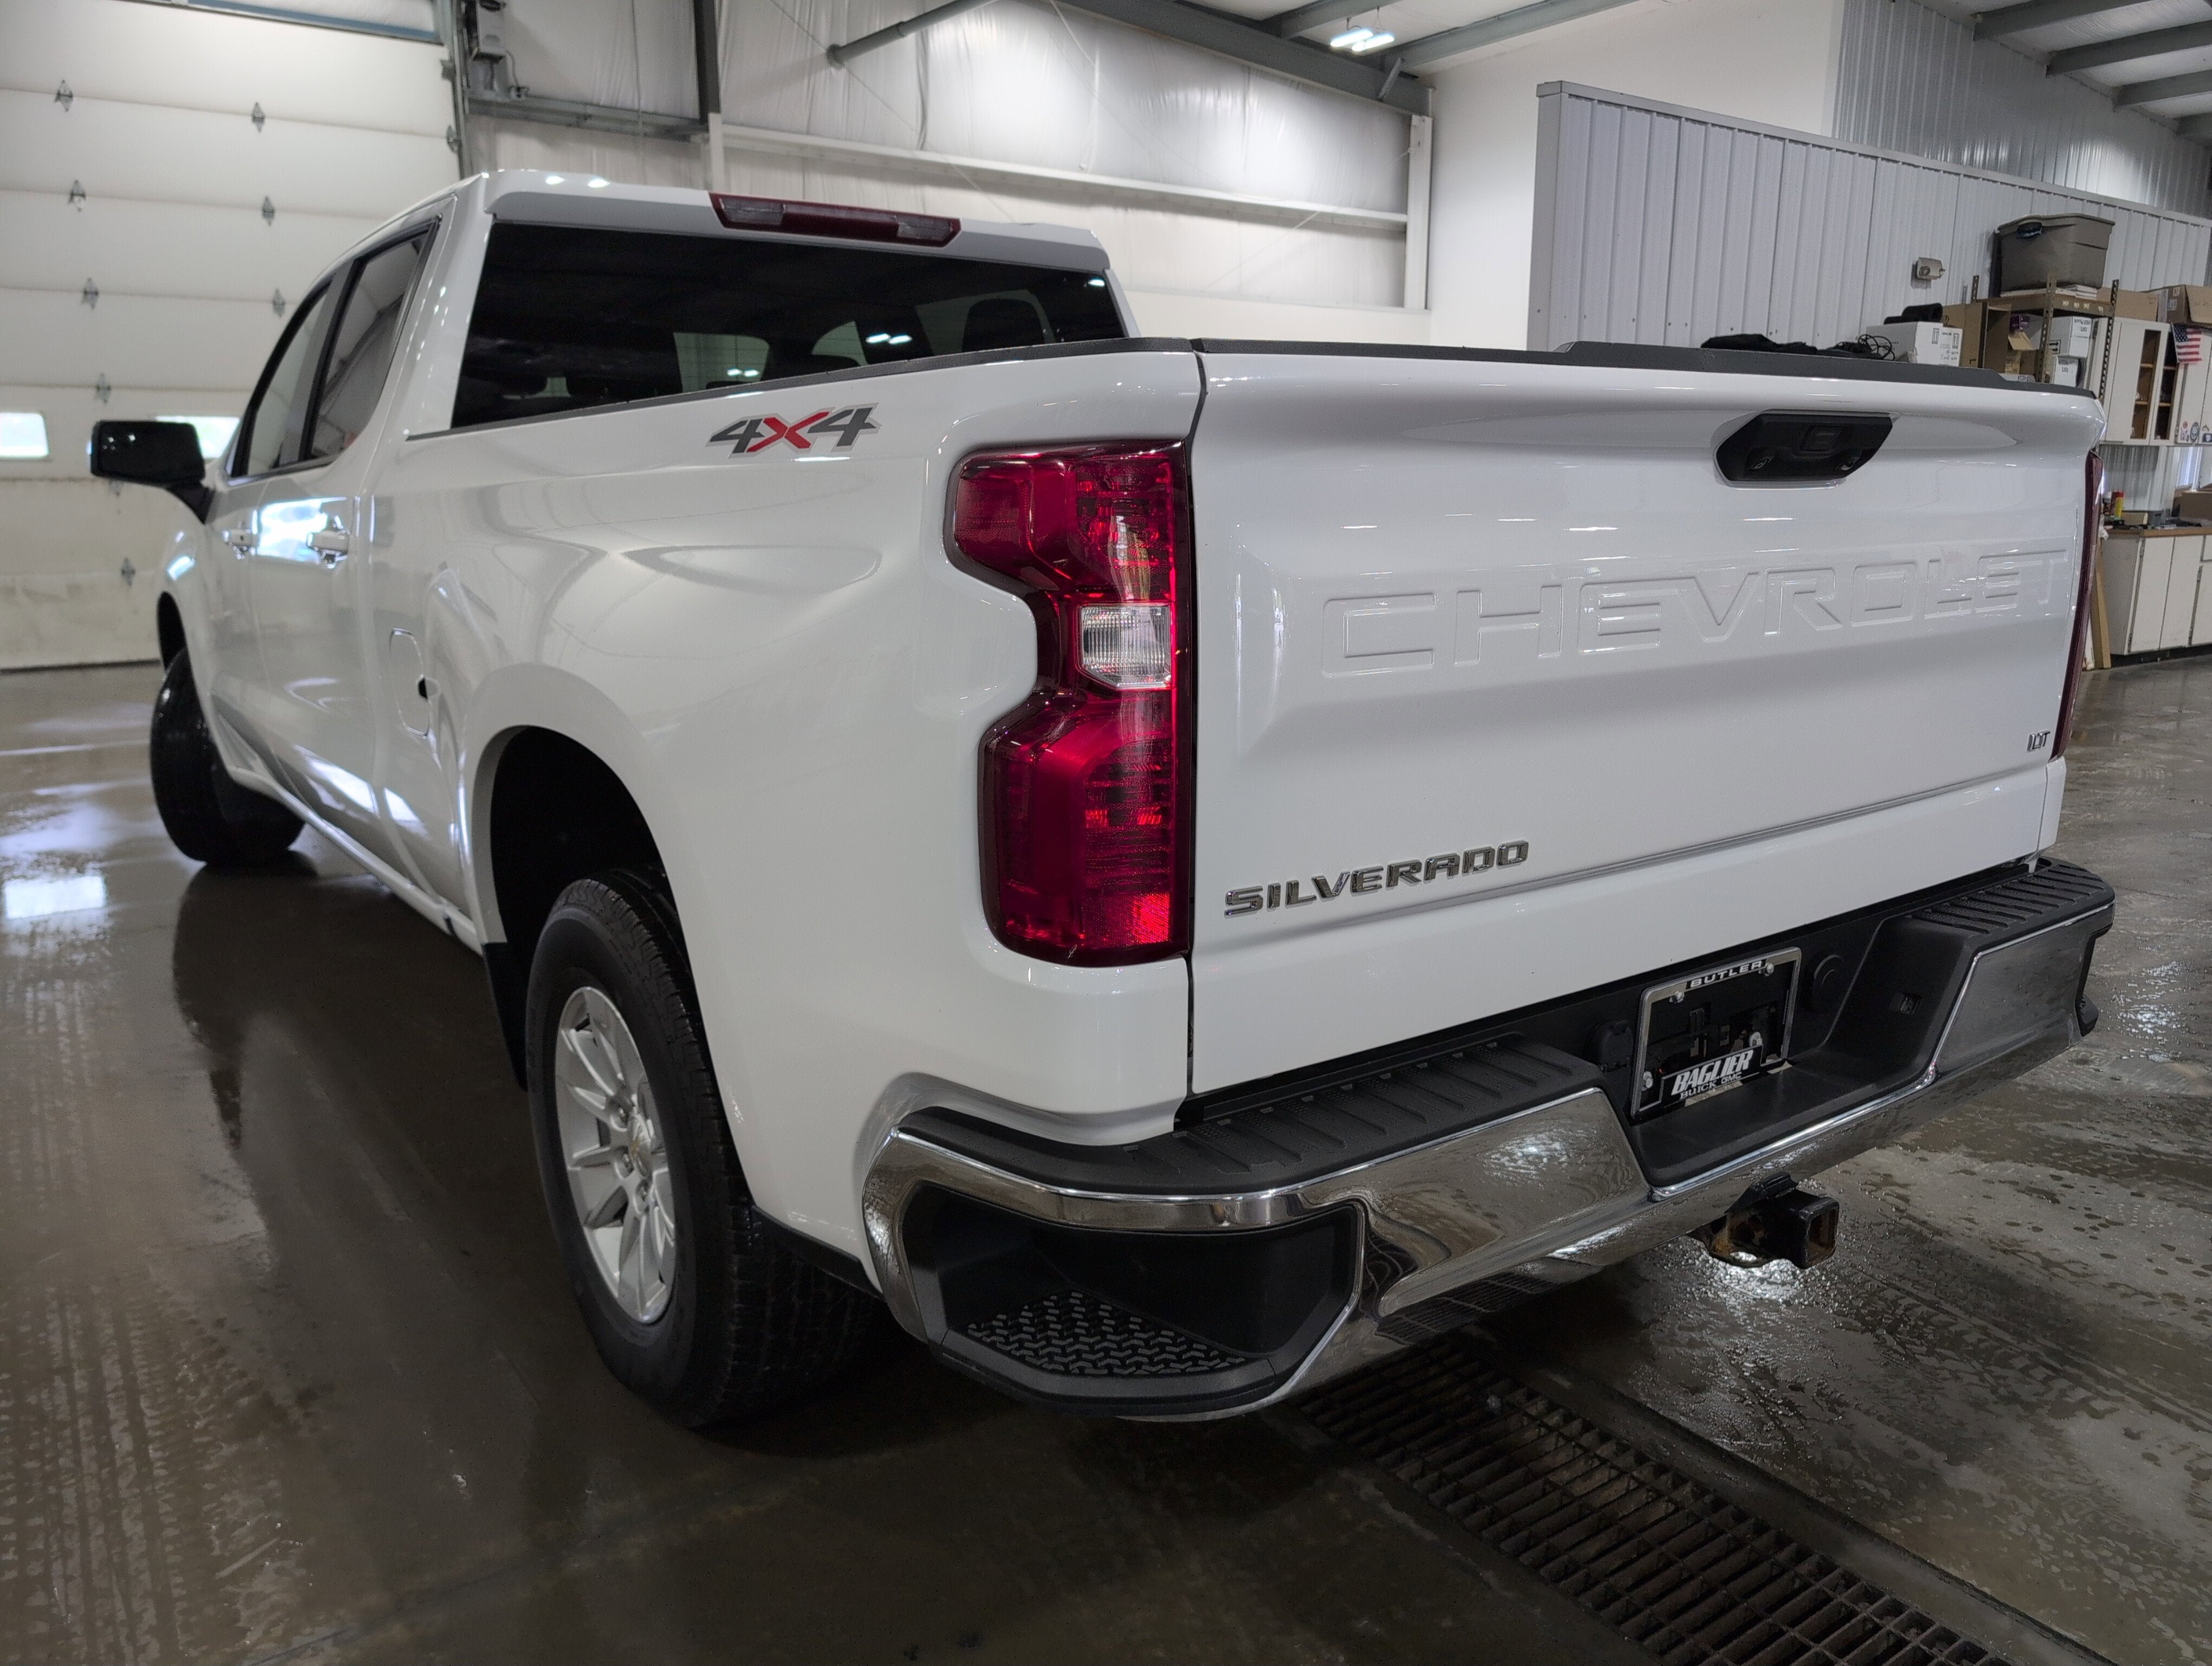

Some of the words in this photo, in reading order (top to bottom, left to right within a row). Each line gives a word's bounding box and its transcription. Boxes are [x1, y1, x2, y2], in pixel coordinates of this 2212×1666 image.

[1322, 549, 2067, 678] CHEVROLET
[1224, 840, 1529, 919] SILVERADO
[1690, 960, 1763, 988] BUTLER
[1671, 1049, 1754, 1095] BAGLIER
[1679, 1080, 1717, 1100] BUICK
[1720, 1072, 1742, 1085] GMC
